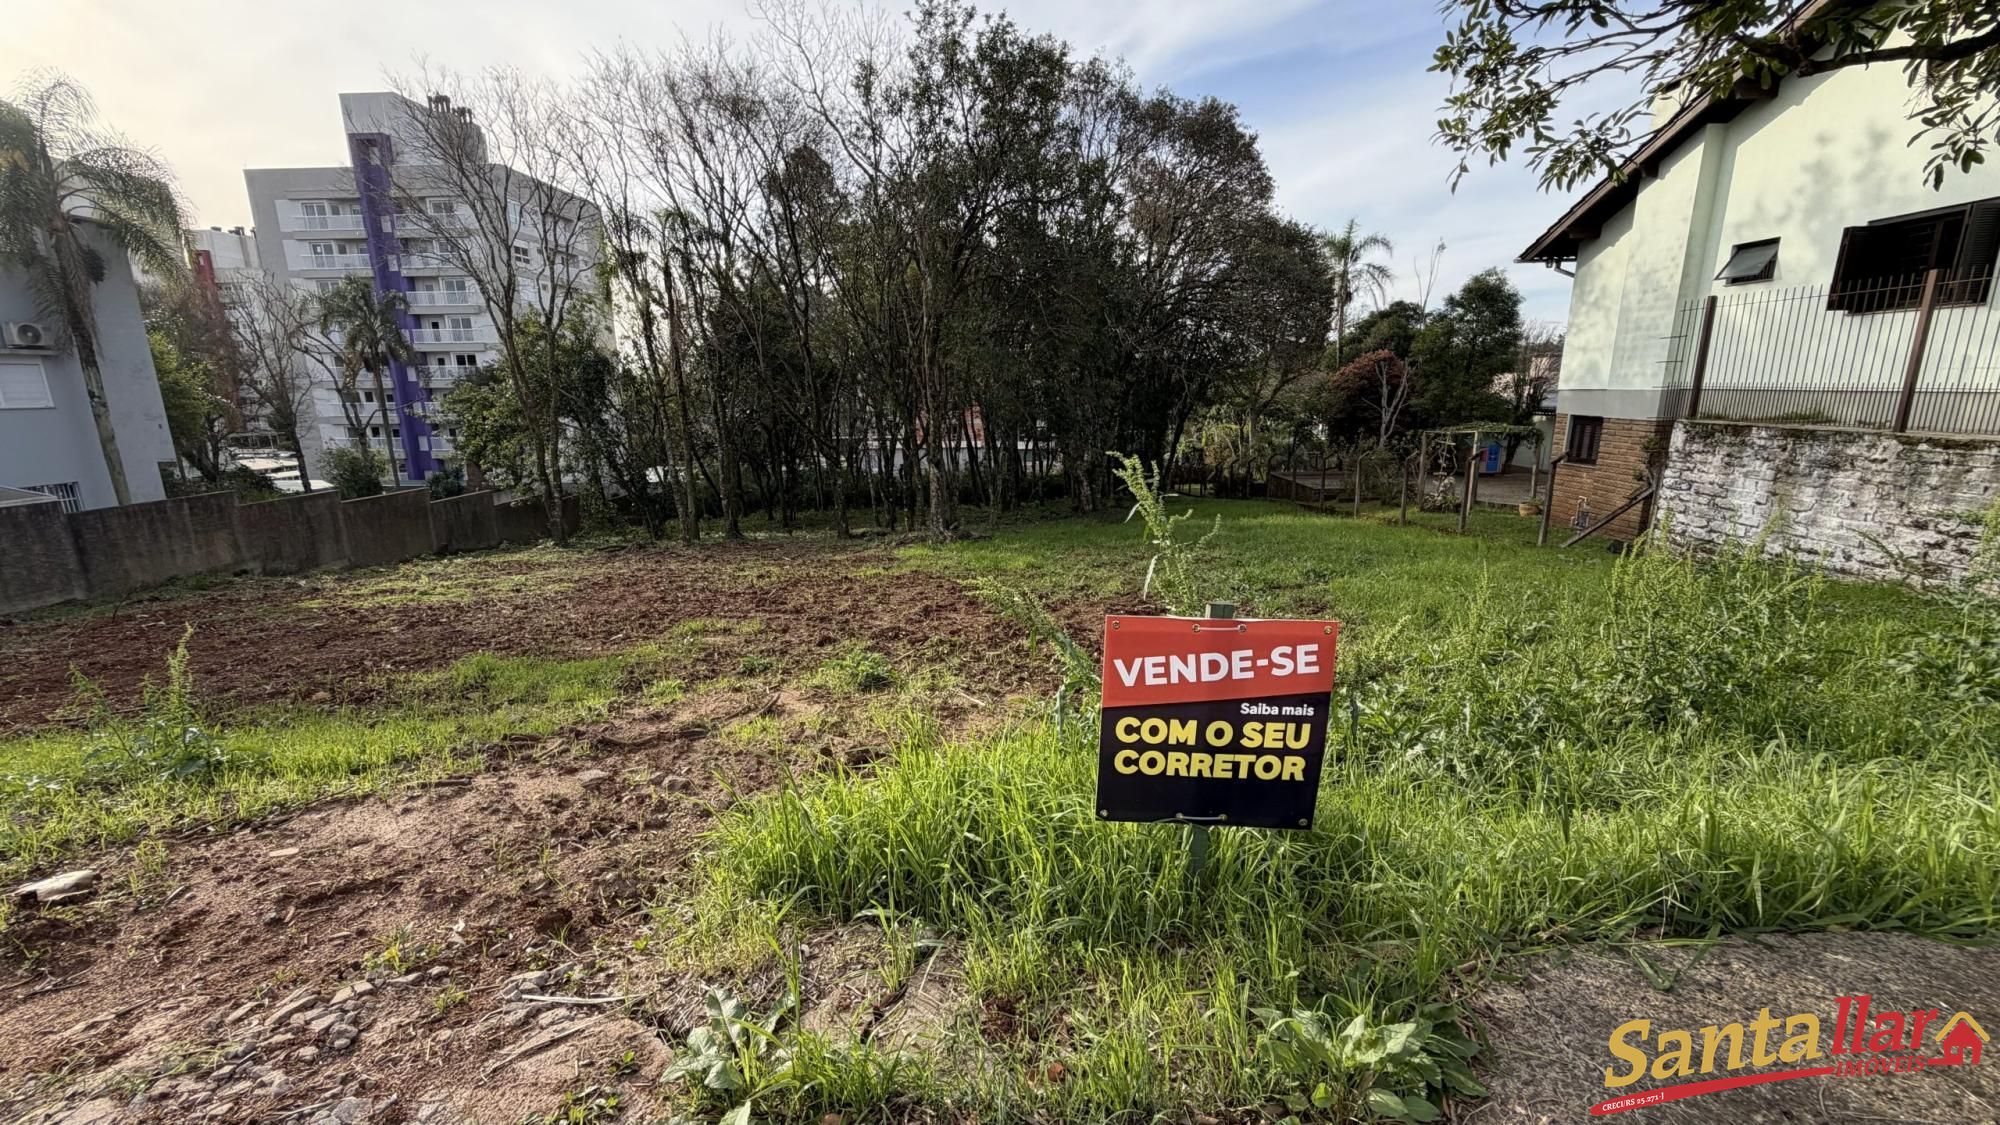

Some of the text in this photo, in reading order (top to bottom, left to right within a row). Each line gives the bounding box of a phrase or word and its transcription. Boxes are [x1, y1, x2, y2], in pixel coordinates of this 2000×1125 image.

[1113, 644, 1320, 687] VENDE-SE
[1240, 703, 1314, 717] Saiba mais
[1115, 716, 1311, 750] COM O SEU
[1114, 749, 1306, 781] CORRETOR
